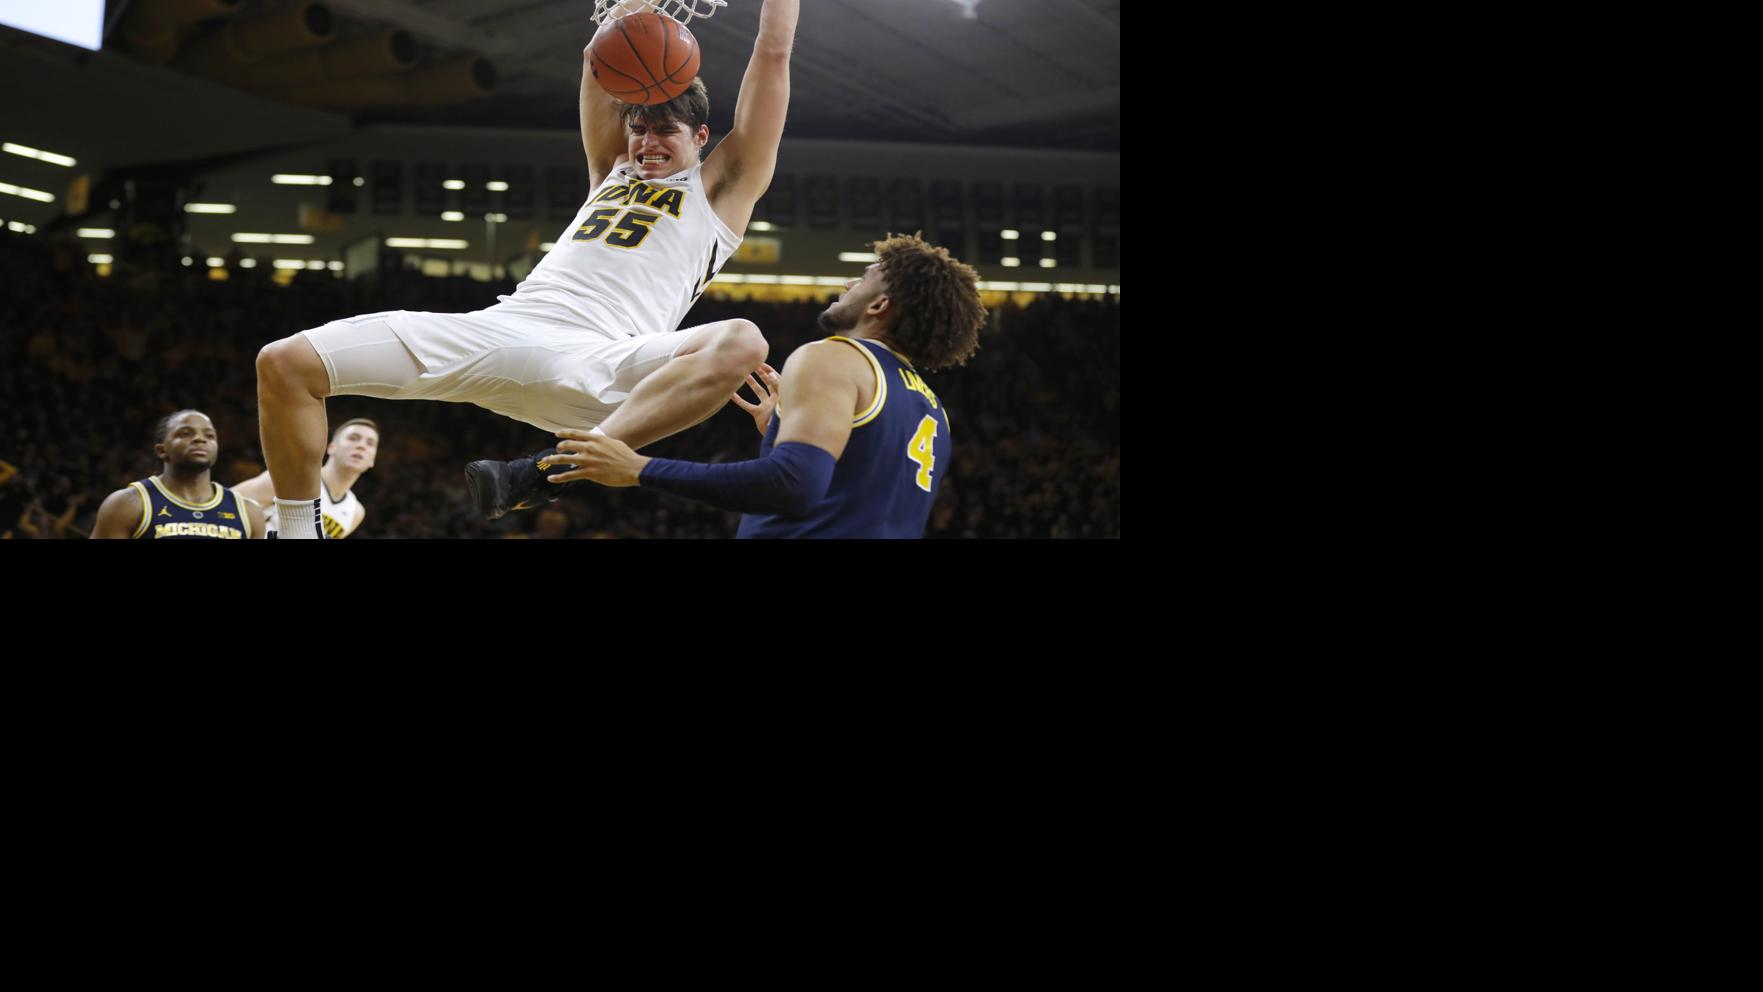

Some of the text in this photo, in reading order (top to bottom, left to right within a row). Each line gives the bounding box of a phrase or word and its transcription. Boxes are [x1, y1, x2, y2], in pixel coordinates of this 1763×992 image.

[572, 208, 662, 249] 55
[907, 414, 938, 492] 4
[154, 522, 242, 539] MICHIGAN
